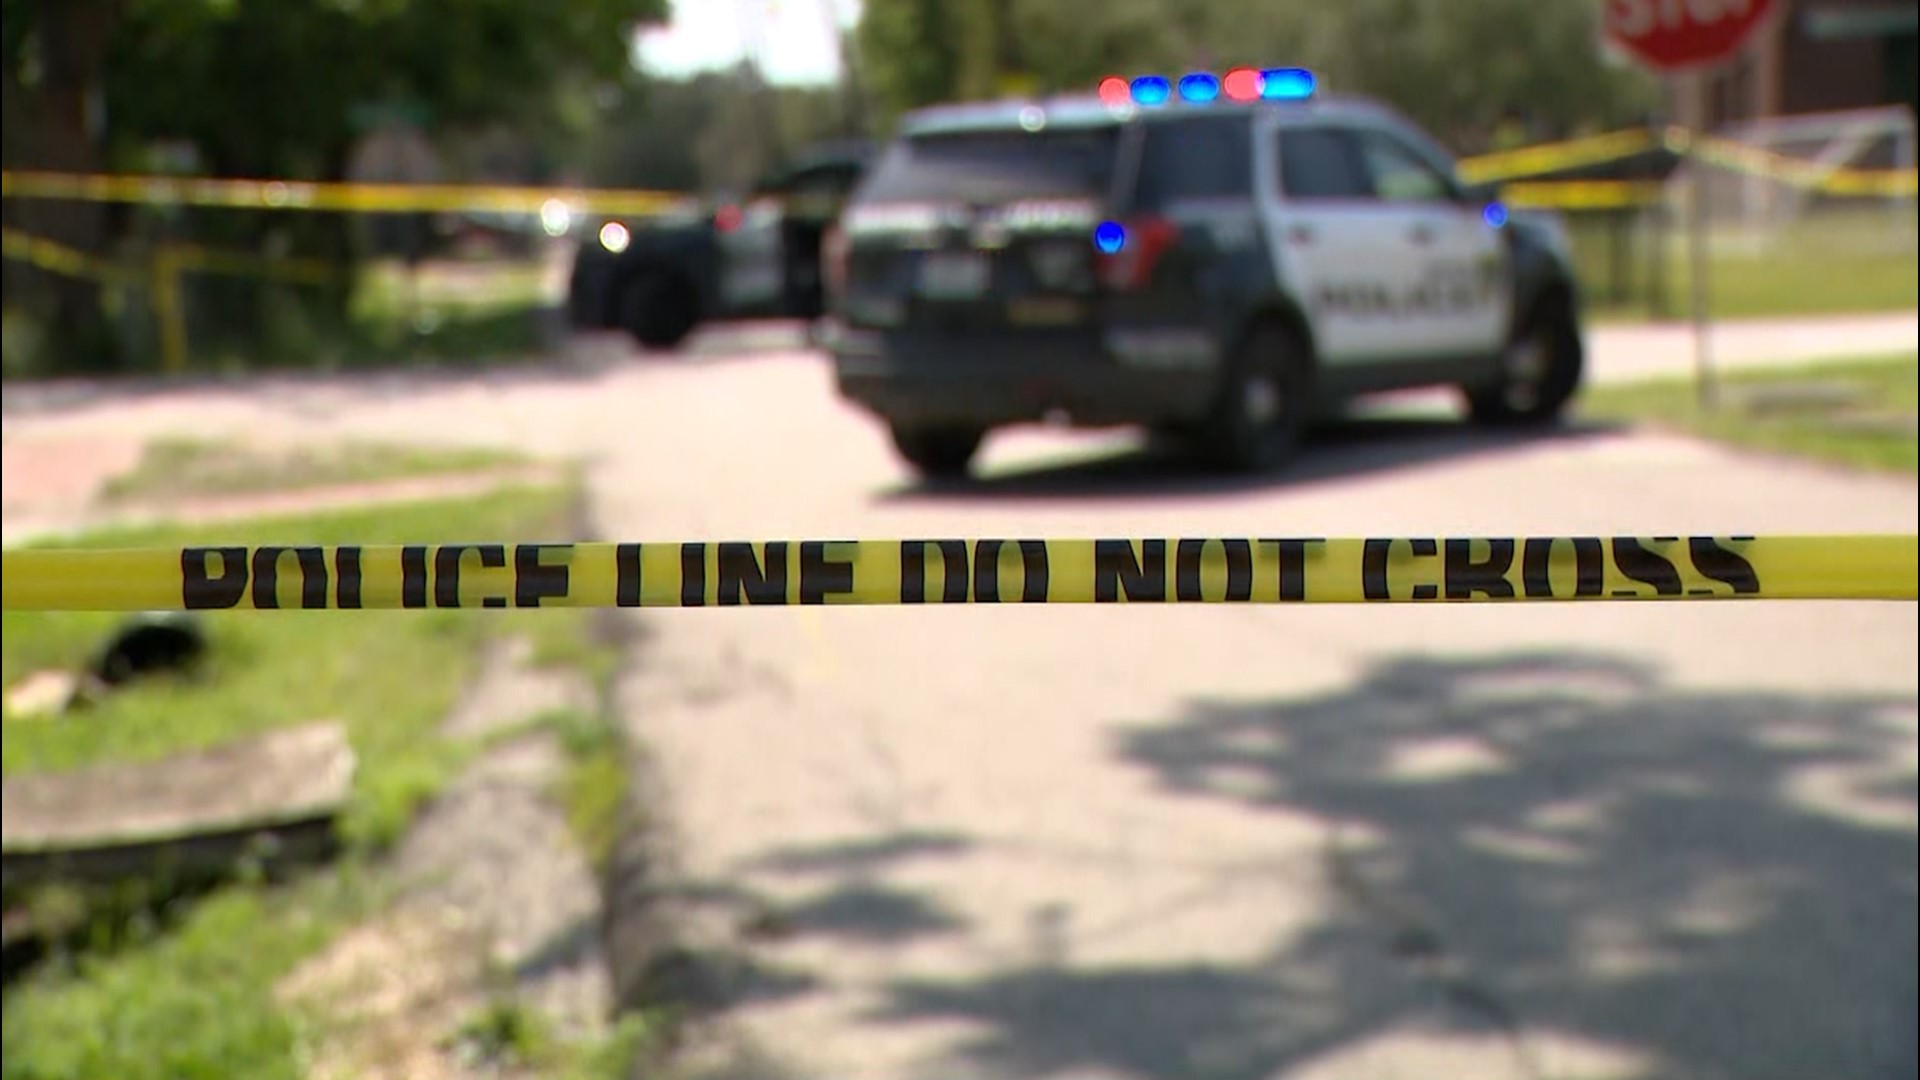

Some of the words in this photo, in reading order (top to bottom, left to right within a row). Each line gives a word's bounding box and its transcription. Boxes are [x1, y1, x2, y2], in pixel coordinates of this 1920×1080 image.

[181, 545, 575, 609] POLICE
[616, 541, 859, 607] LINE
[900, 539, 1049, 604] DO
[1094, 538, 1327, 603] NOT
[1362, 536, 1761, 600] CROSS
